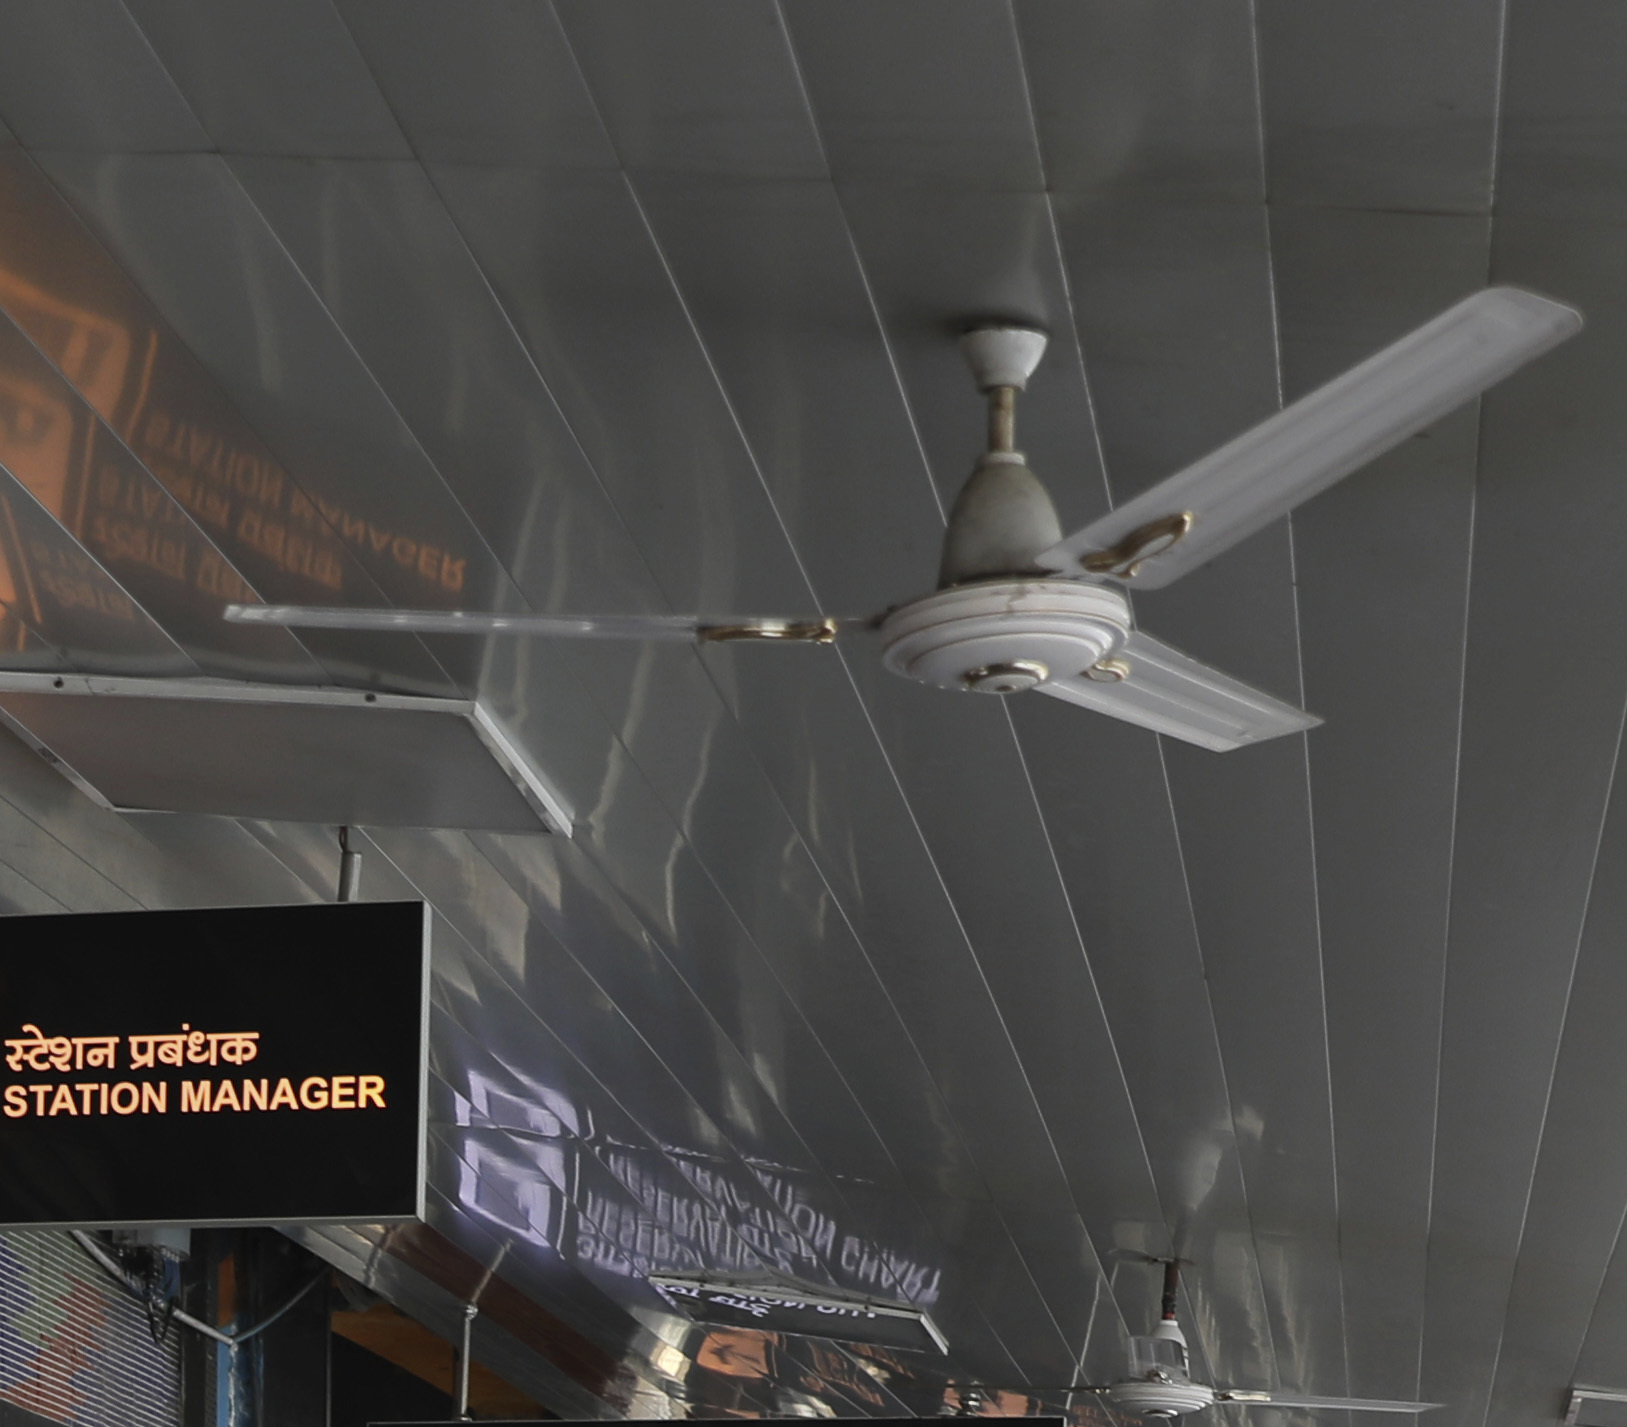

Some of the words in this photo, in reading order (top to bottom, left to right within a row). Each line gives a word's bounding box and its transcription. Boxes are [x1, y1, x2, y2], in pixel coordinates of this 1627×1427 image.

[4, 1024, 119, 1072] स्टेशन
[128, 1023, 260, 1071] प्रबंधक
[3, 1081, 167, 1118] STATION
[180, 1075, 387, 1112] MANAGER
